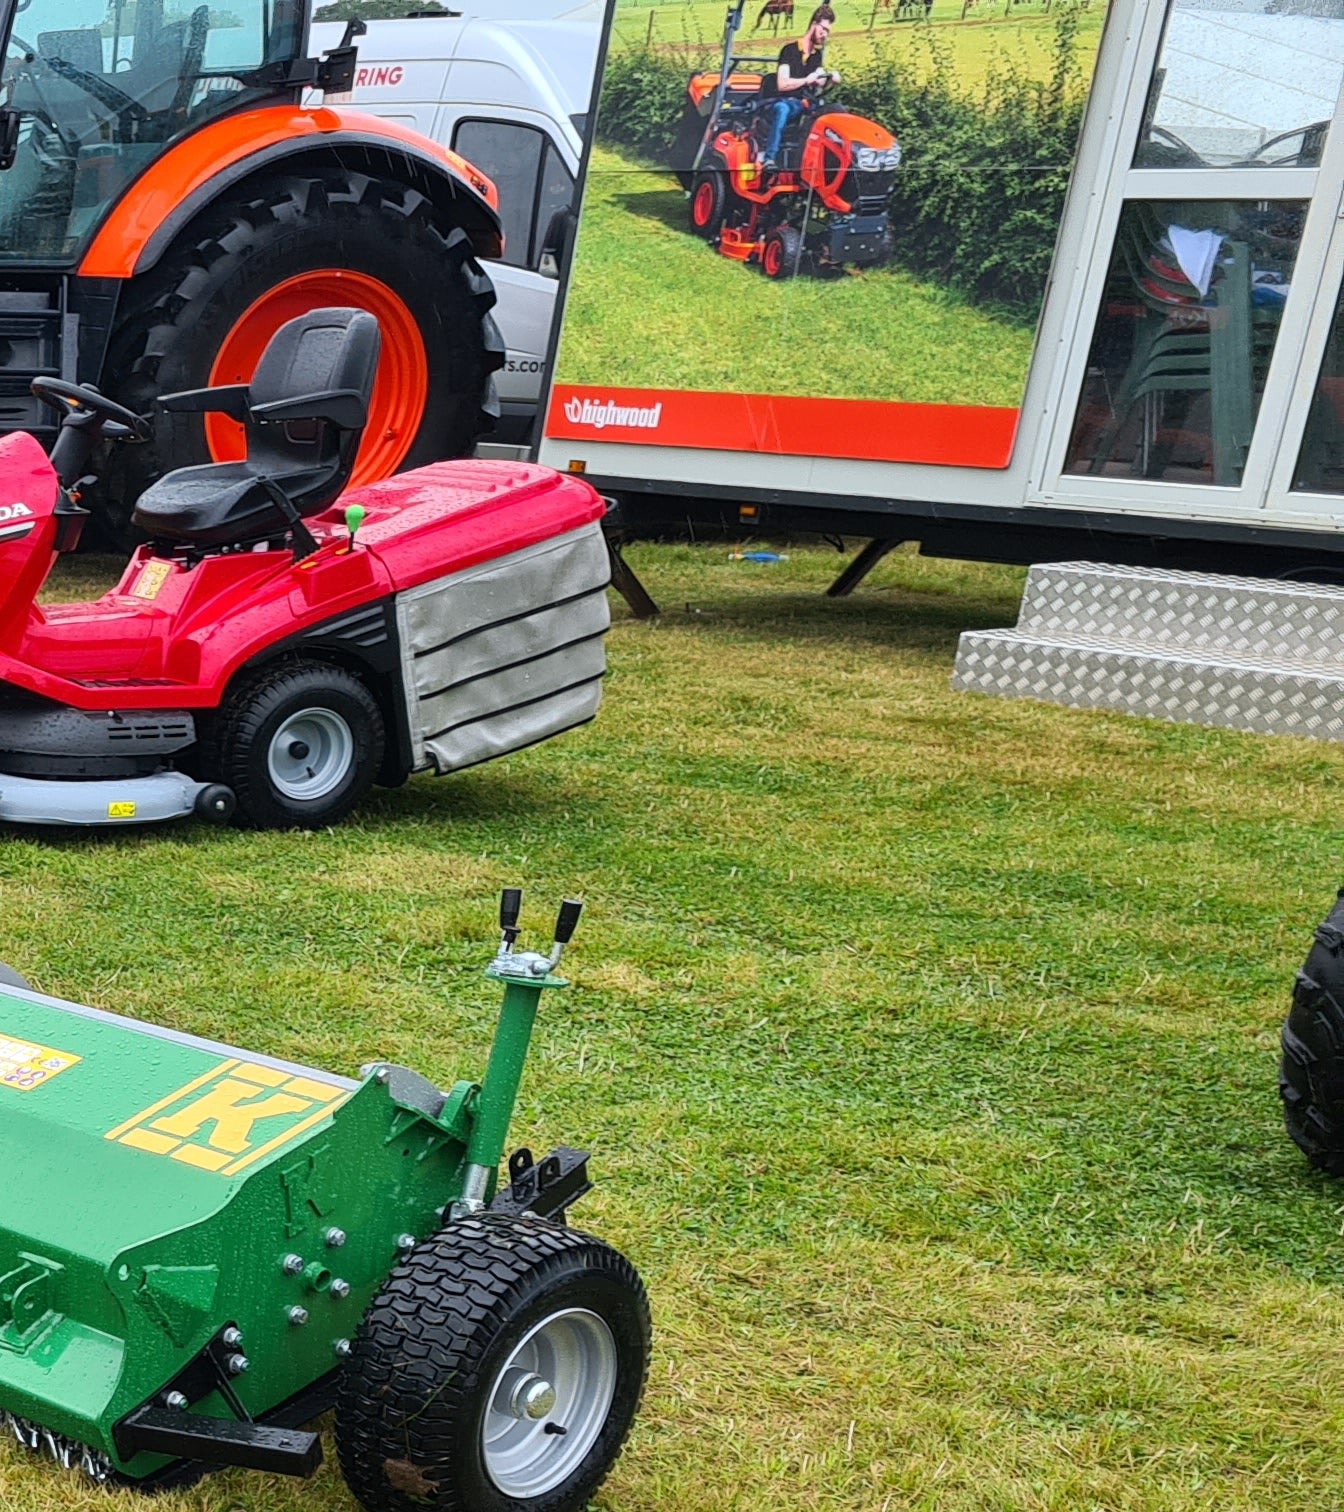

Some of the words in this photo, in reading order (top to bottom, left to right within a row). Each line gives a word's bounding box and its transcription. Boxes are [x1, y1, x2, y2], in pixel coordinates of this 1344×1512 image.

[355, 66, 403, 87] RING
[502, 360, 546, 373] rs.co
[581, 399, 662, 428] highwood
